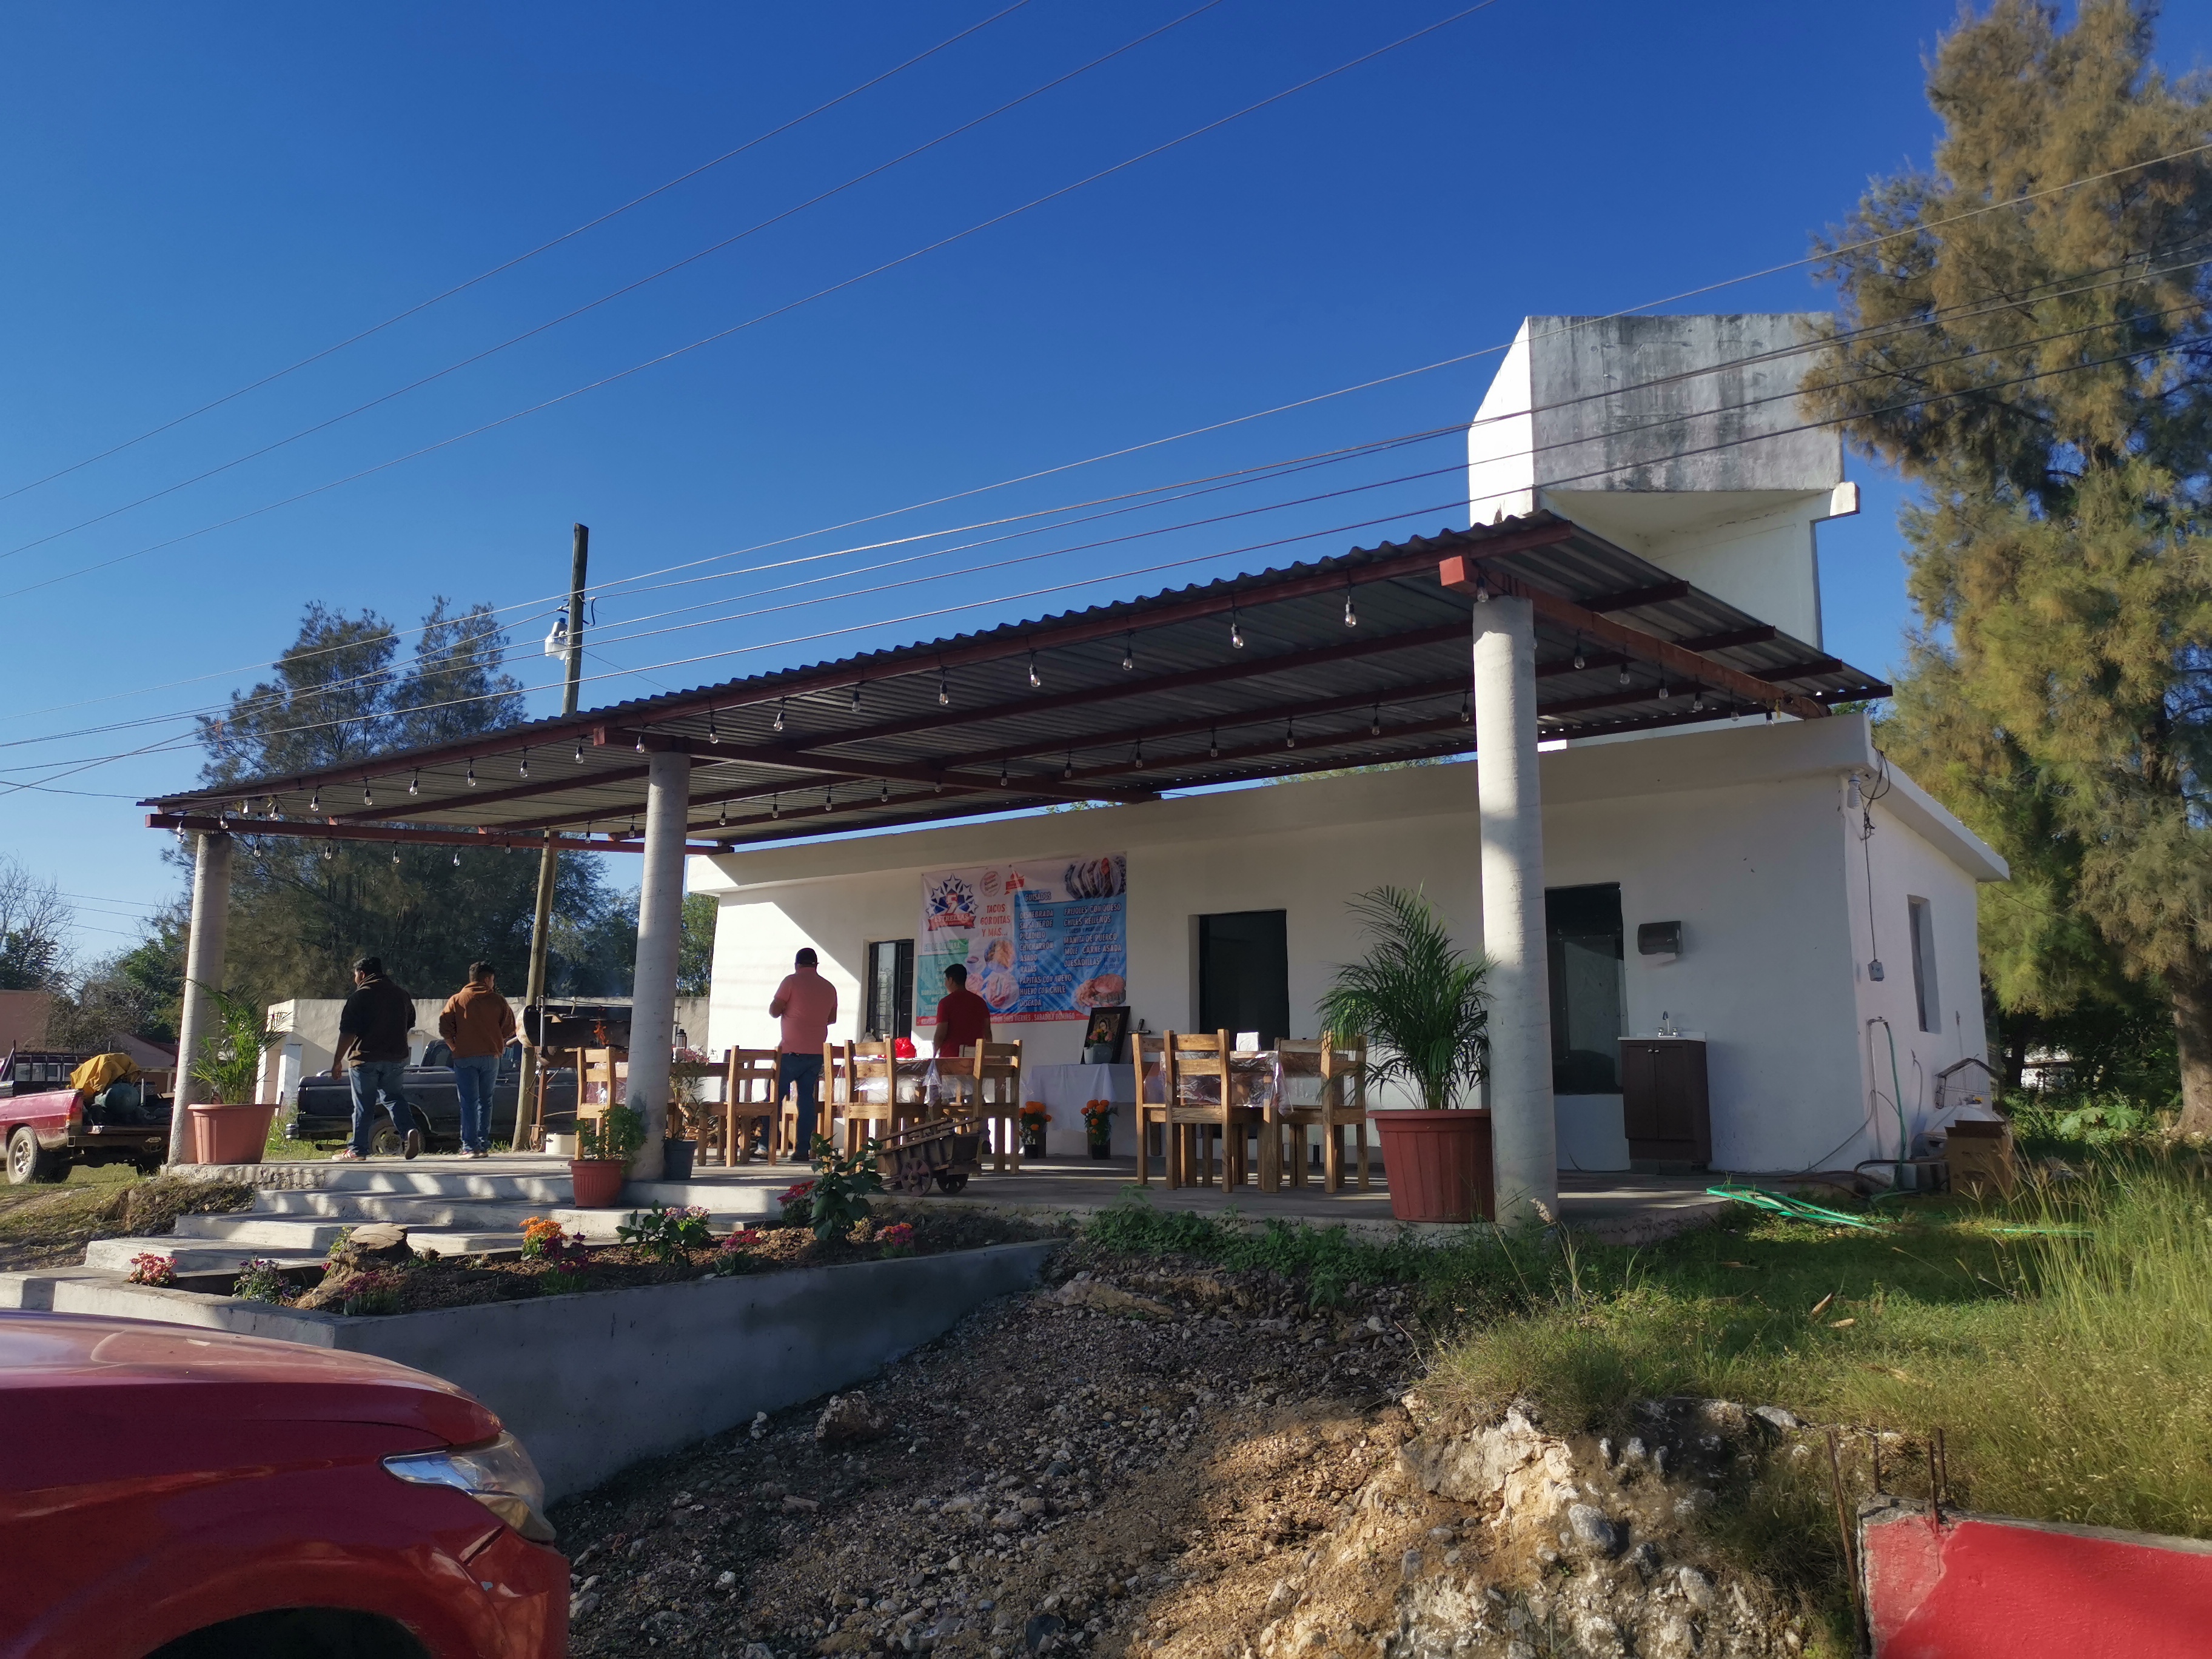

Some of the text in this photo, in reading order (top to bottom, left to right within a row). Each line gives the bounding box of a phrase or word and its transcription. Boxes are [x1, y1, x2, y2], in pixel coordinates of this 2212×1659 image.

[1025, 891, 1051, 902] GUISADOS
[987, 904, 1005, 913] TACOS
[1064, 906, 1088, 916] FRIJOLES
[1102, 903, 1121, 912] QUESO
[934, 914, 969, 922] ESTRELLAS
[980, 916, 1010, 925] GORDITAS
[1064, 916, 1111, 927] CHILES RELLENOS
[1036, 919, 1053, 928] VERDE
[982, 928, 987, 937] Y
[1019, 931, 1045, 940] PICADILLO
[1094, 933, 1118, 942] PUERCO
[1064, 947, 1078, 956] MOLE
[1102, 944, 1122, 953] ASADA
[1064, 957, 1101, 967] QUESADILLAS
[1054, 974, 1072, 982] HUEVO
[1019, 987, 1037, 996] HUEVO
